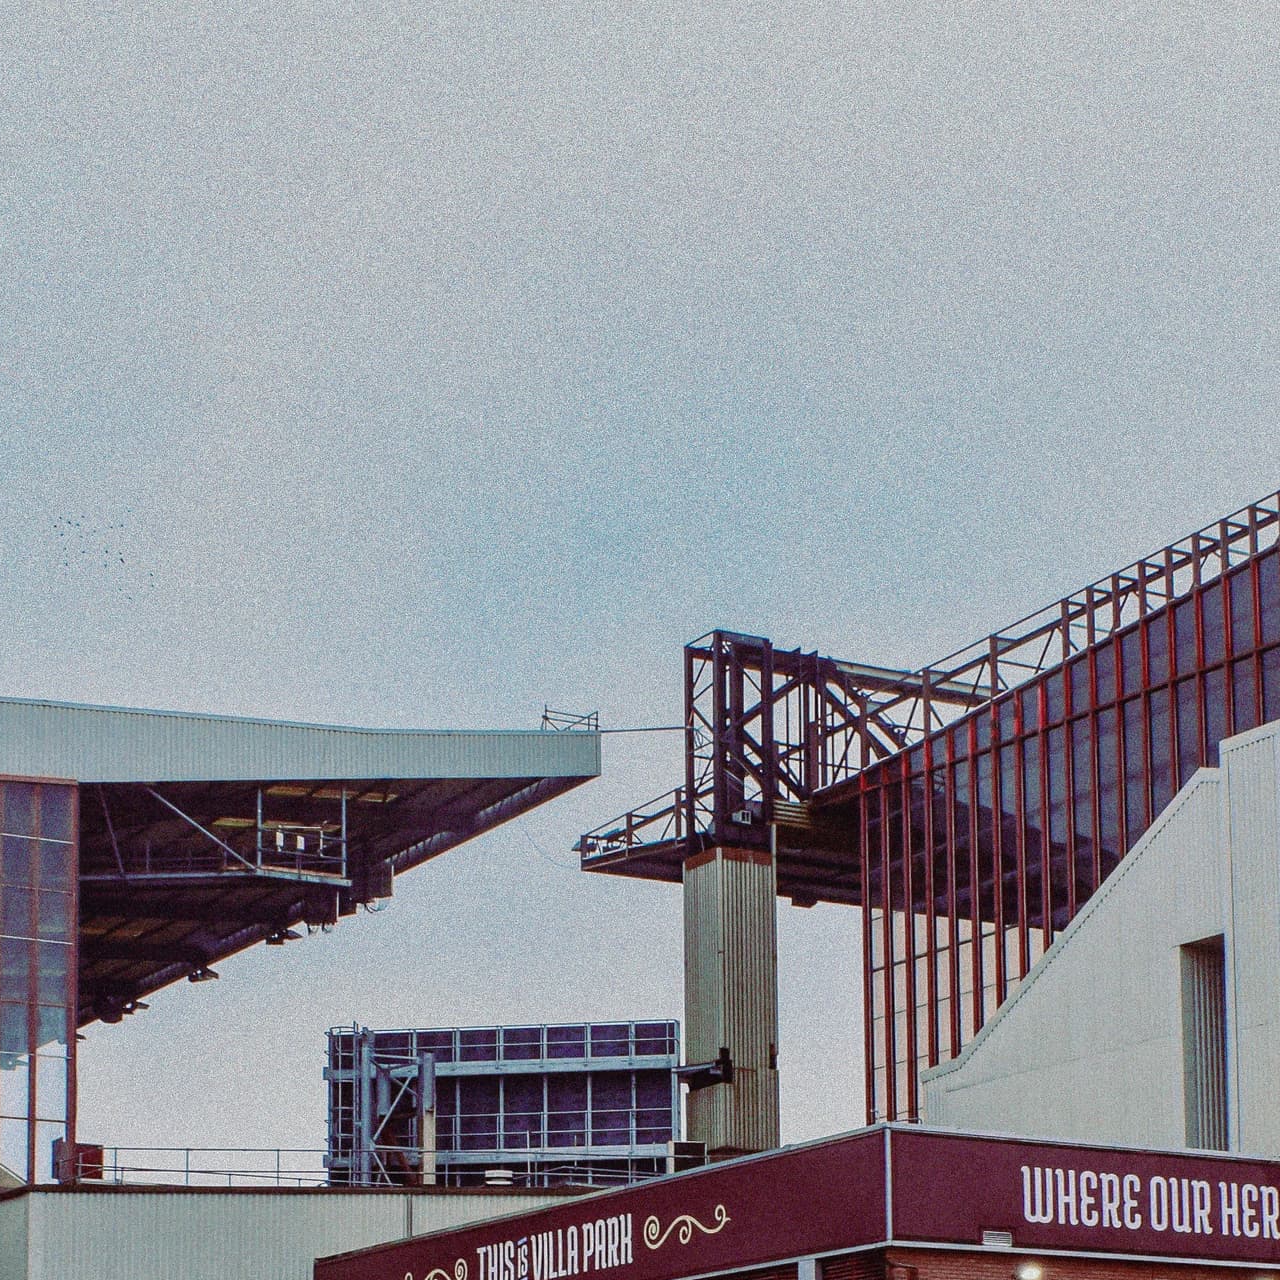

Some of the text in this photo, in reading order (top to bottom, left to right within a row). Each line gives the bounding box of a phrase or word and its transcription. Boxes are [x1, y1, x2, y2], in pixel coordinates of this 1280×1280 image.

[1021, 1165, 1142, 1230] WHERE
[1149, 1175, 1213, 1235] OUR
[518, 1240, 528, 1280] IS
[582, 1213, 634, 1274] PARK
